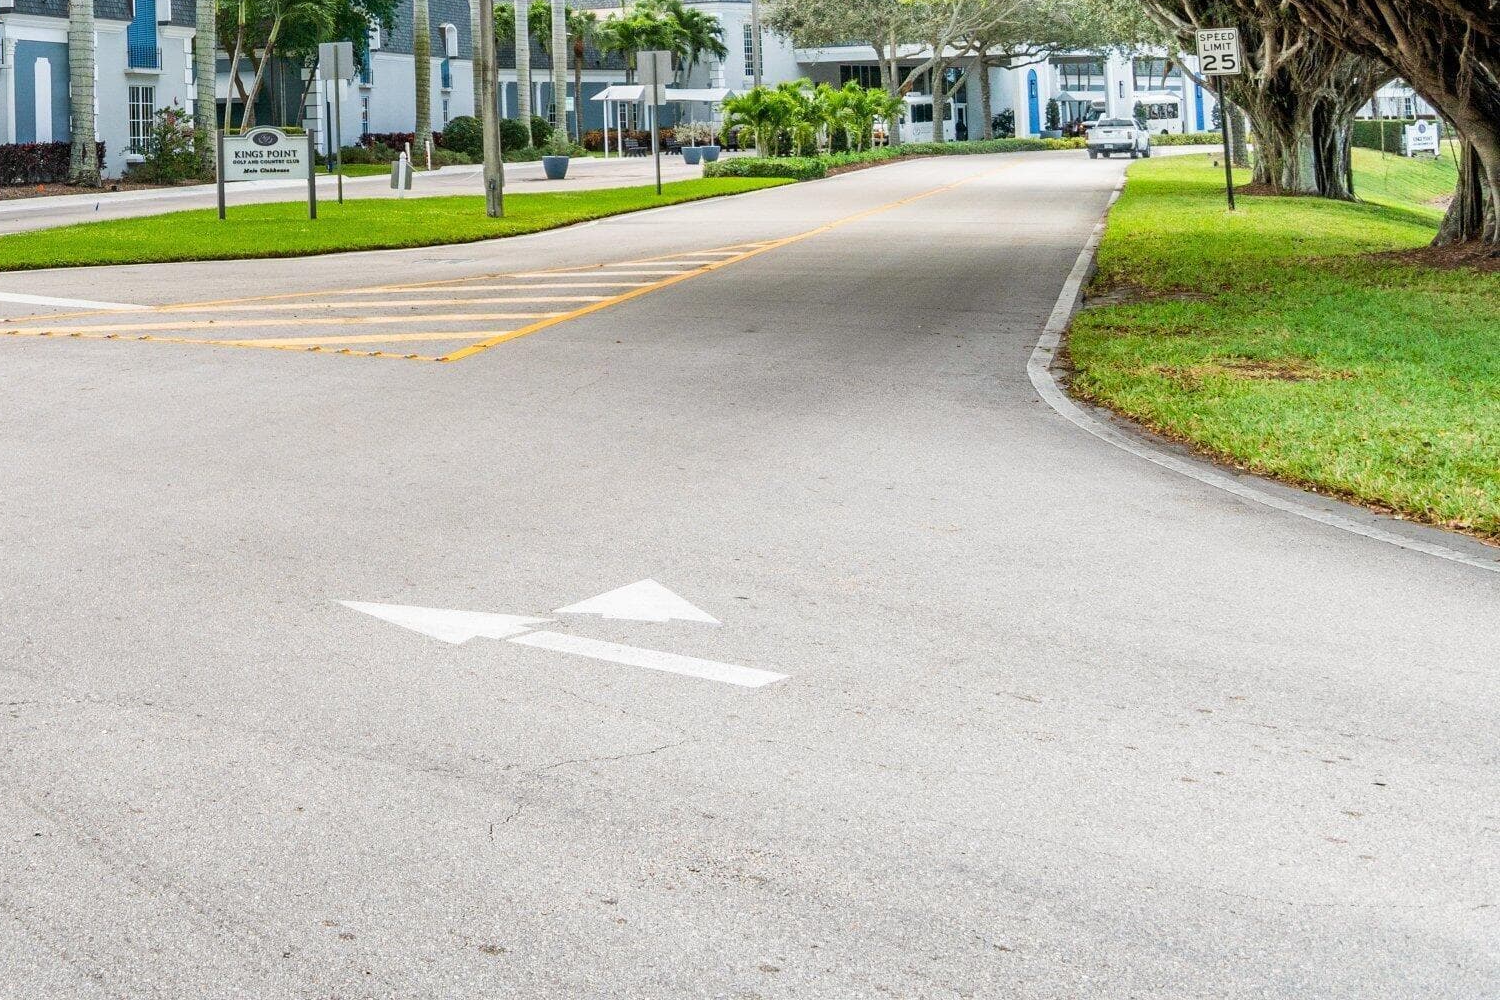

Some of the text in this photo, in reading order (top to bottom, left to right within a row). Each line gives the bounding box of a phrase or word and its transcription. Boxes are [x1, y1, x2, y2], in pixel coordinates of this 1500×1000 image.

[1199, 32, 1235, 42] SPEED
[1203, 42, 1232, 52] LIMIT
[1202, 53, 1236, 71] 25
[234, 149, 298, 158] KINGS POINT
